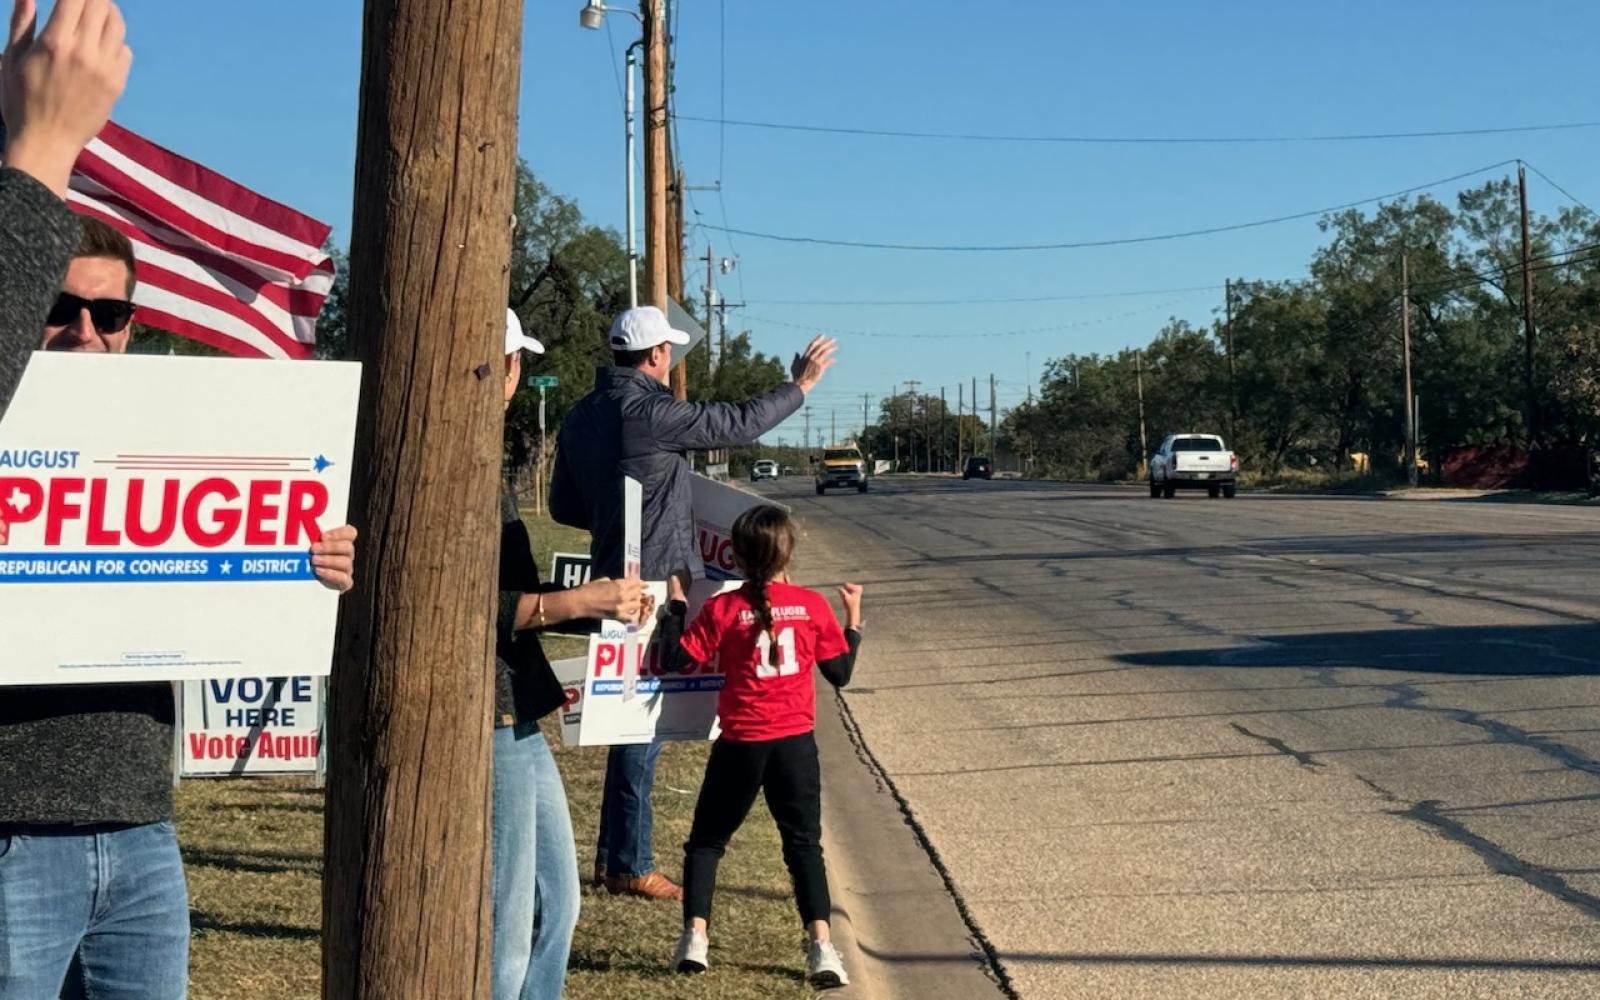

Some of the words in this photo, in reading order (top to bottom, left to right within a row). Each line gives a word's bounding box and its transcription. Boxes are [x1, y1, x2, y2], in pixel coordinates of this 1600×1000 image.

[0, 450, 80, 469] AUGUST
[0, 477, 329, 547] PFLUGER
[0, 559, 91, 575] REPUBLICAN
[95, 559, 125, 575] FOR
[129, 559, 208, 575] CONGRESS
[242, 559, 300, 574] DISTRICT
[755, 627, 800, 678] 11
[210, 676, 312, 703] VOTE
[226, 707, 295, 727] HERE
[190, 733, 251, 760] Vote
